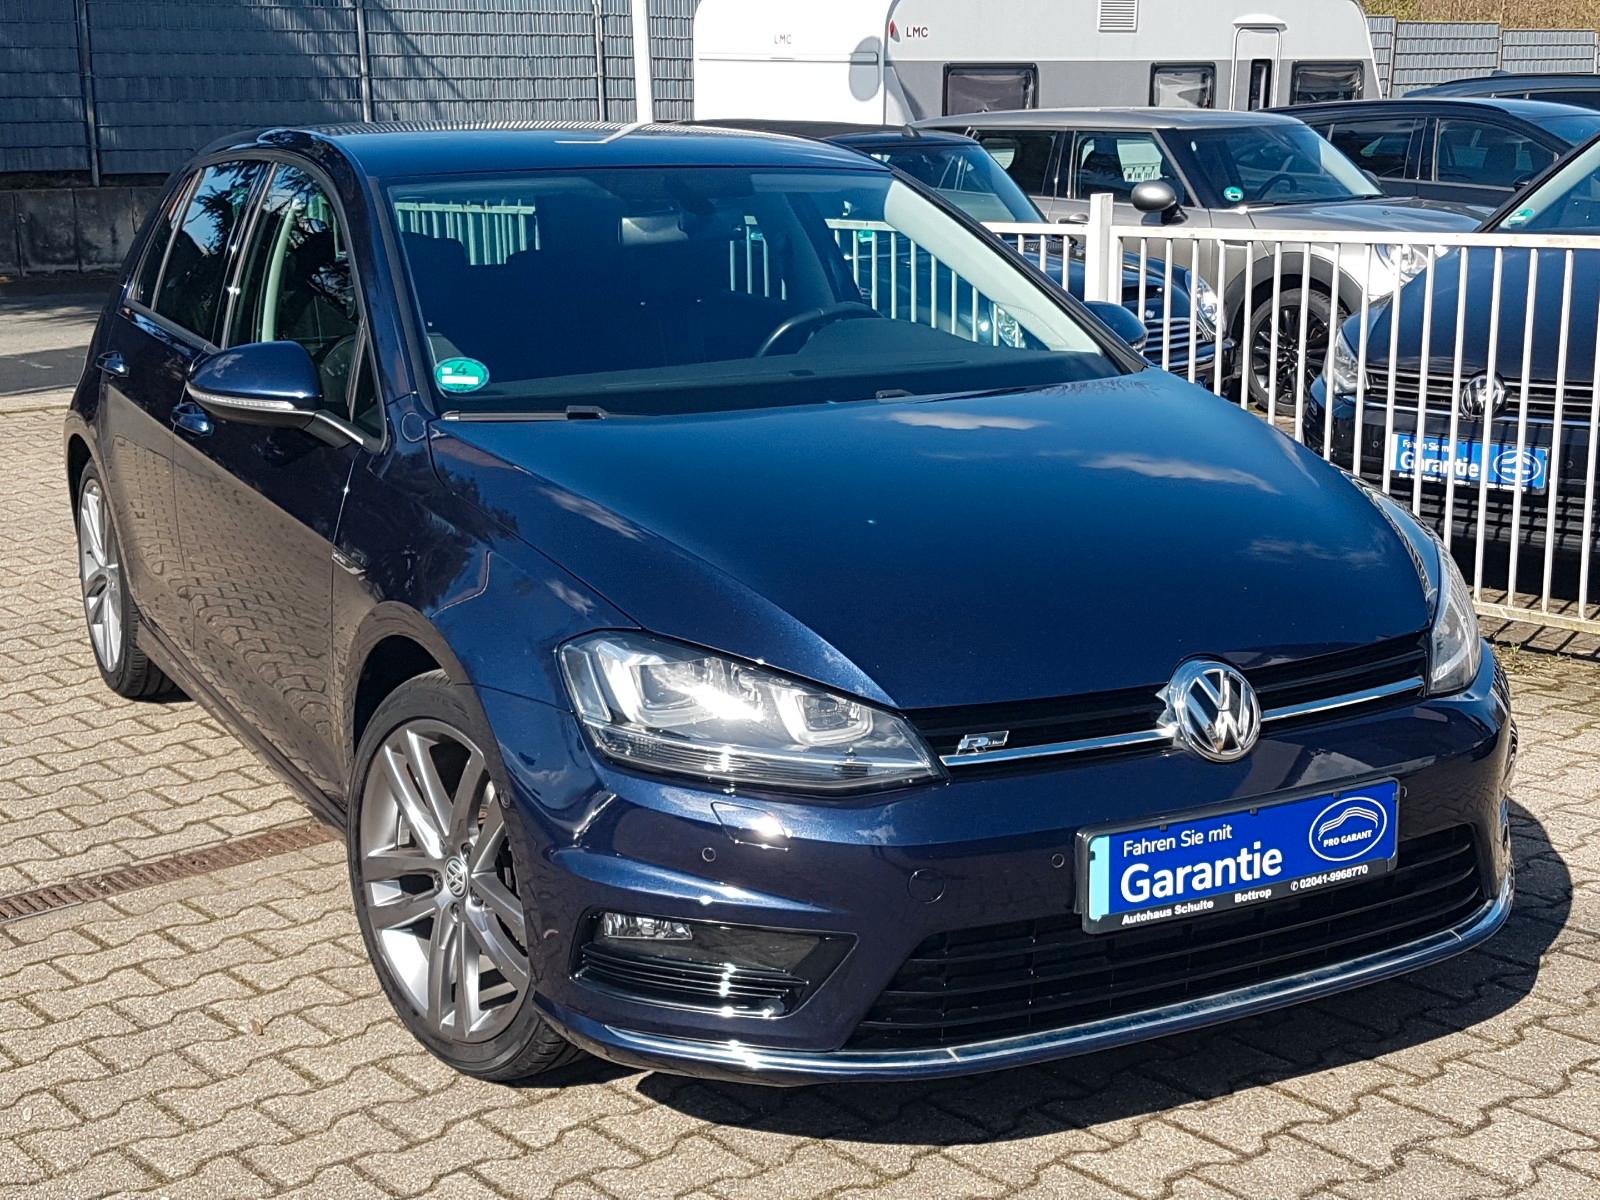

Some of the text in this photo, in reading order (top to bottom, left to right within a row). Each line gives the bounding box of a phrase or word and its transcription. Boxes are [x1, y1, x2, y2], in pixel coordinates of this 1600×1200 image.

[774, 34, 792, 45] LMC
[906, 26, 929, 38] LMC
[454, 362, 468, 375] 4
[1123, 824, 1233, 858] Fahren Sie mit
[1323, 829, 1373, 848] PRO GARANT
[1120, 841, 1283, 903] Garantie
[1234, 888, 1272, 903] Bottrop
[1121, 899, 1214, 925] Autohaus Schulte
